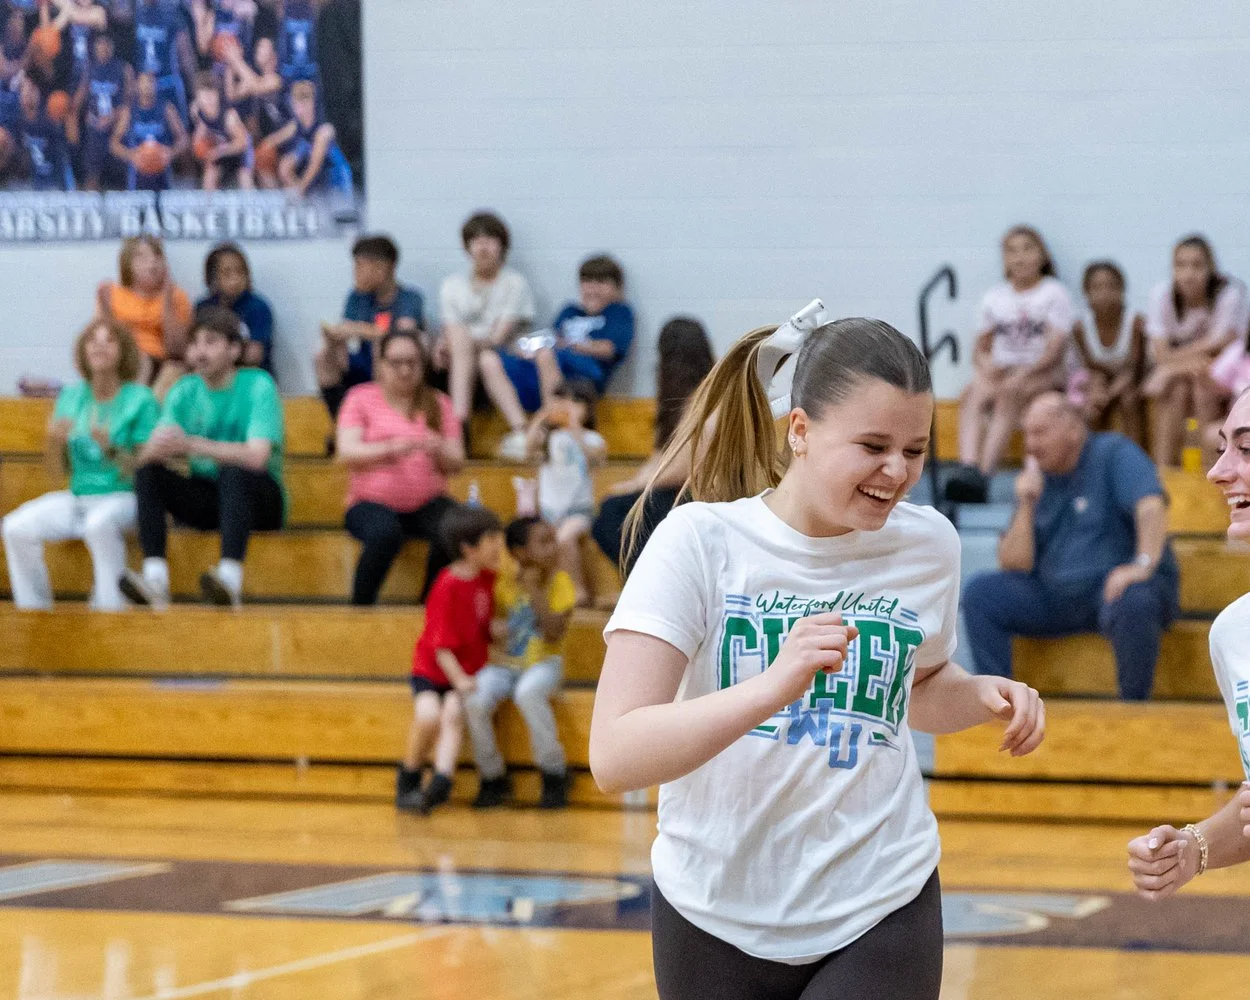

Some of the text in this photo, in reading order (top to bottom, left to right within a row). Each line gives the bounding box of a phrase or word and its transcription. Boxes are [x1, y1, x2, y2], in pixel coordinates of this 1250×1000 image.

[120, 205, 318, 238] BASKETBALL
[755, 590, 899, 620] Waterford United
